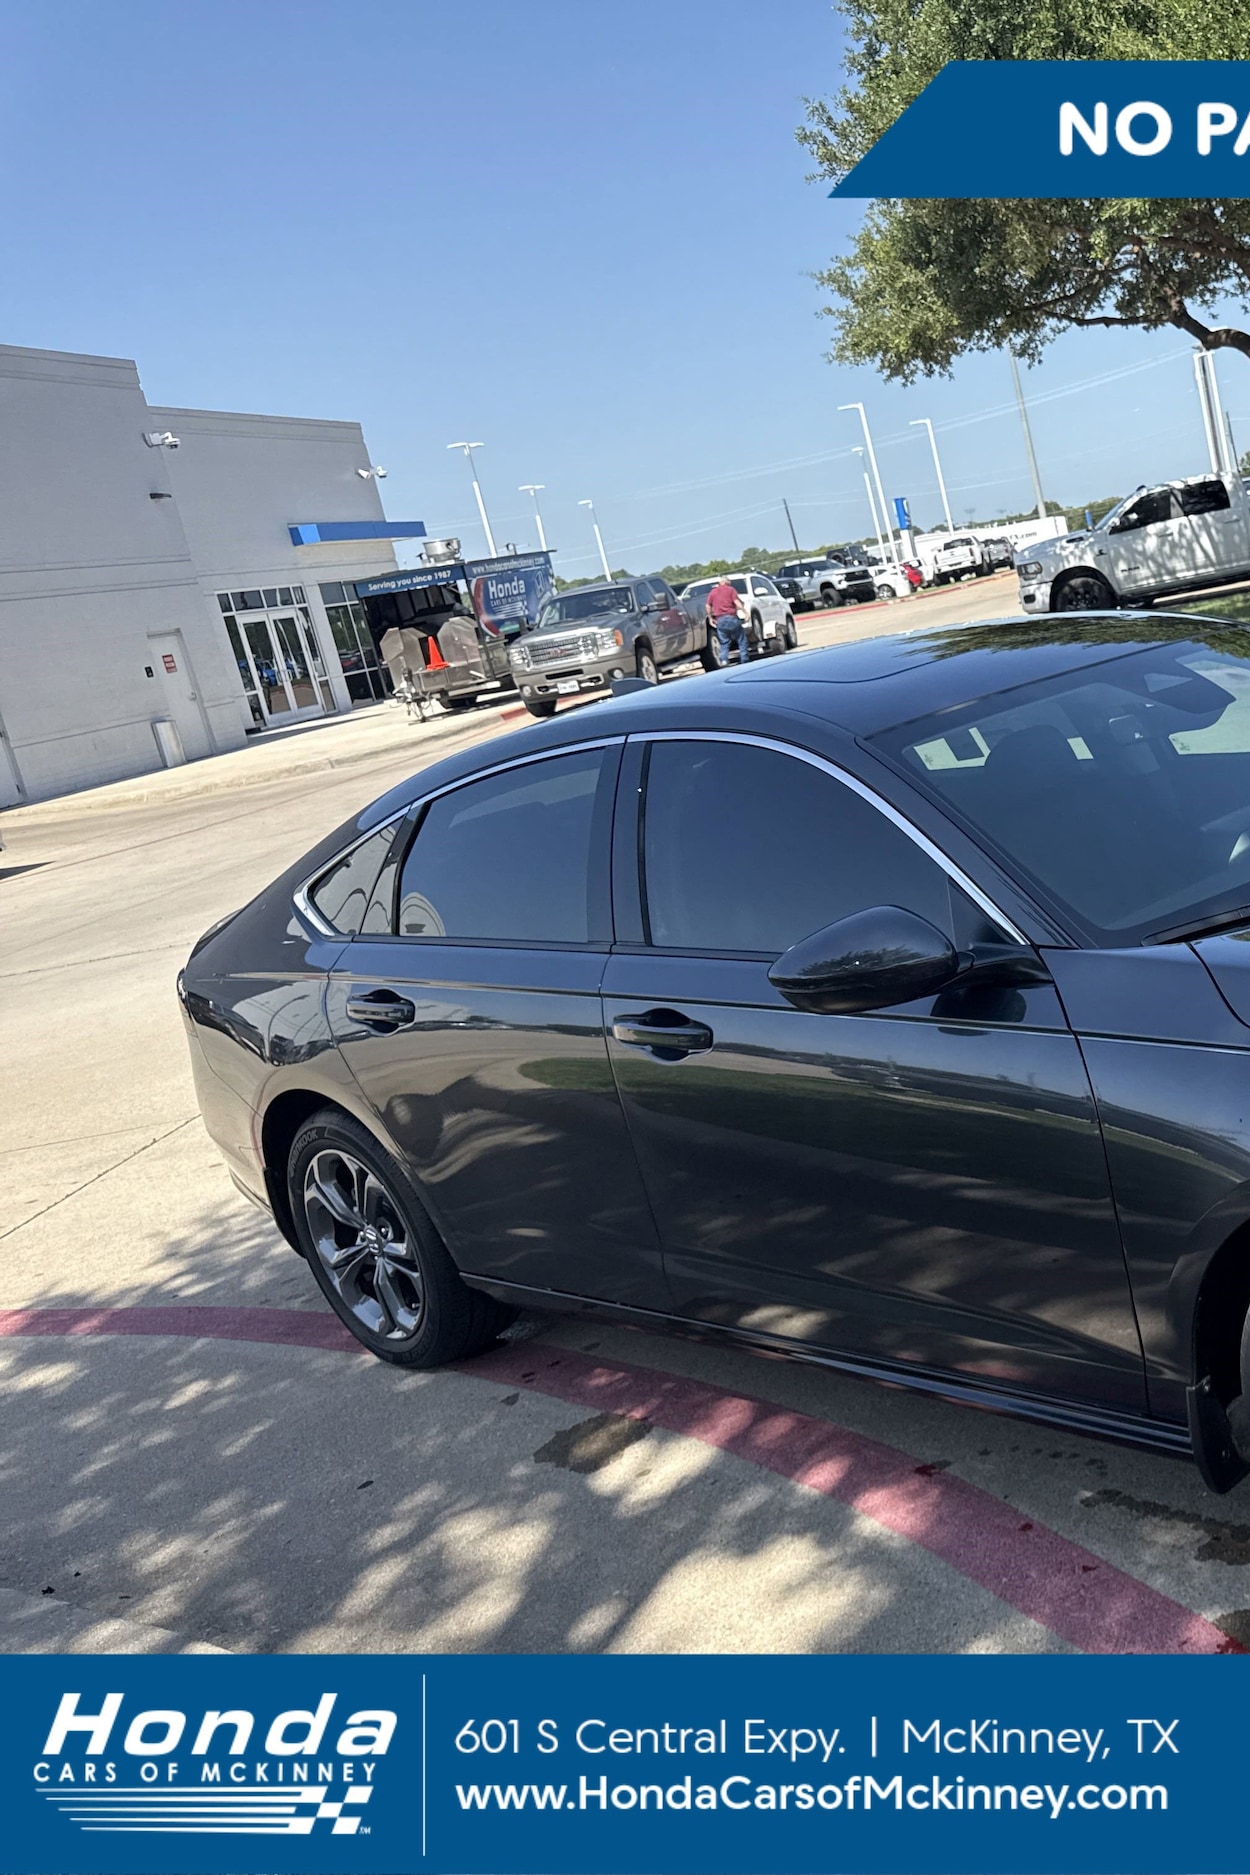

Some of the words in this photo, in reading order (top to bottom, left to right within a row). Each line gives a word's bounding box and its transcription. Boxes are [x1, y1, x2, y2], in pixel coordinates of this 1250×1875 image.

[368, 581, 396, 591] Serving
[397, 578, 411, 587] you
[413, 574, 432, 583] since
[434, 570, 451, 579] 1987
[488, 576, 526, 600] Honda
